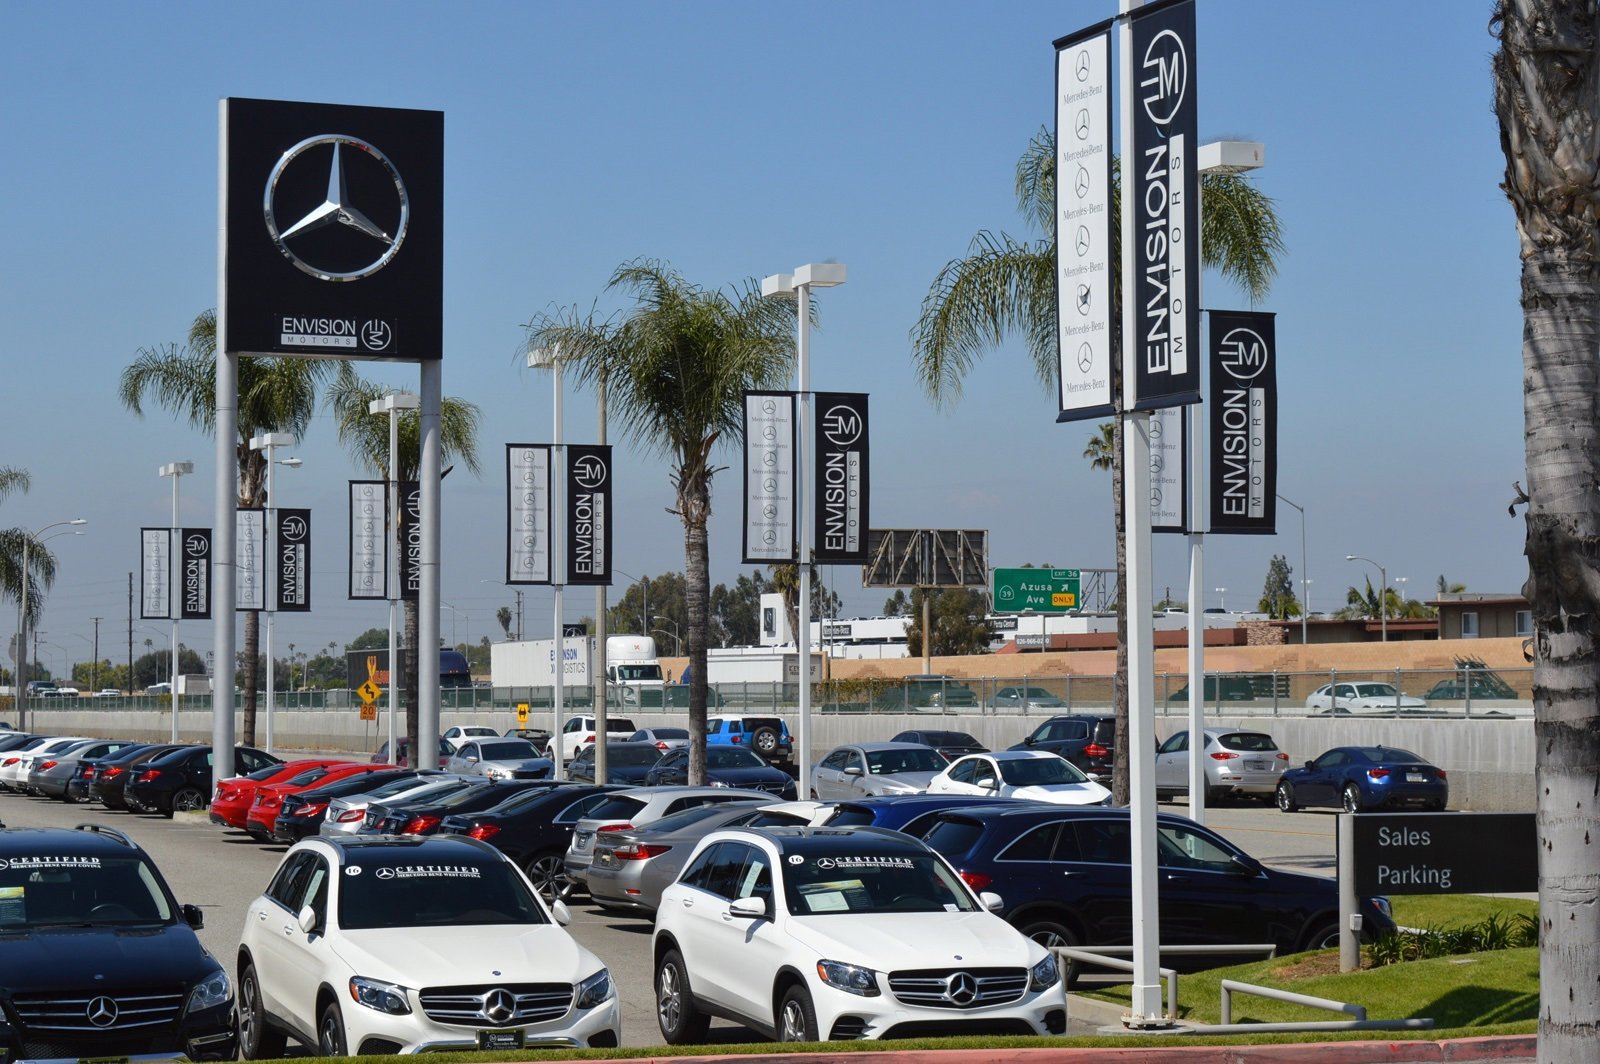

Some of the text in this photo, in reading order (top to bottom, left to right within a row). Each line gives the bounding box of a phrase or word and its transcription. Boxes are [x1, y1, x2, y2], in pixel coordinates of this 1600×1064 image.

[1145, 144, 1169, 375] ENVISION
[1171, 156, 1183, 354] MOTORS
[282, 317, 356, 336] ENVISION
[287, 336, 350, 345] MOTORS
[1223, 389, 1247, 515] ENVISION
[1251, 399, 1262, 507] MOTORS
[825, 452, 845, 550] ENVISION
[848, 459, 857, 544] MOTORS
[575, 494, 592, 573] ENVISION
[283, 544, 296, 603] ENVISION
[408, 522, 420, 590] ENVISION
[187, 560, 198, 612] ENVISION
[1002, 590, 1012, 598] 39
[1020, 582, 1053, 592] Azusa
[1026, 595, 1045, 604] Ave
[362, 706, 374, 715] 20
[1378, 826, 1431, 846] Sales
[395, 865, 479, 873] CERTIFIED
[835, 856, 912, 864] CERTIFIED
[1378, 864, 1452, 889] Parking
